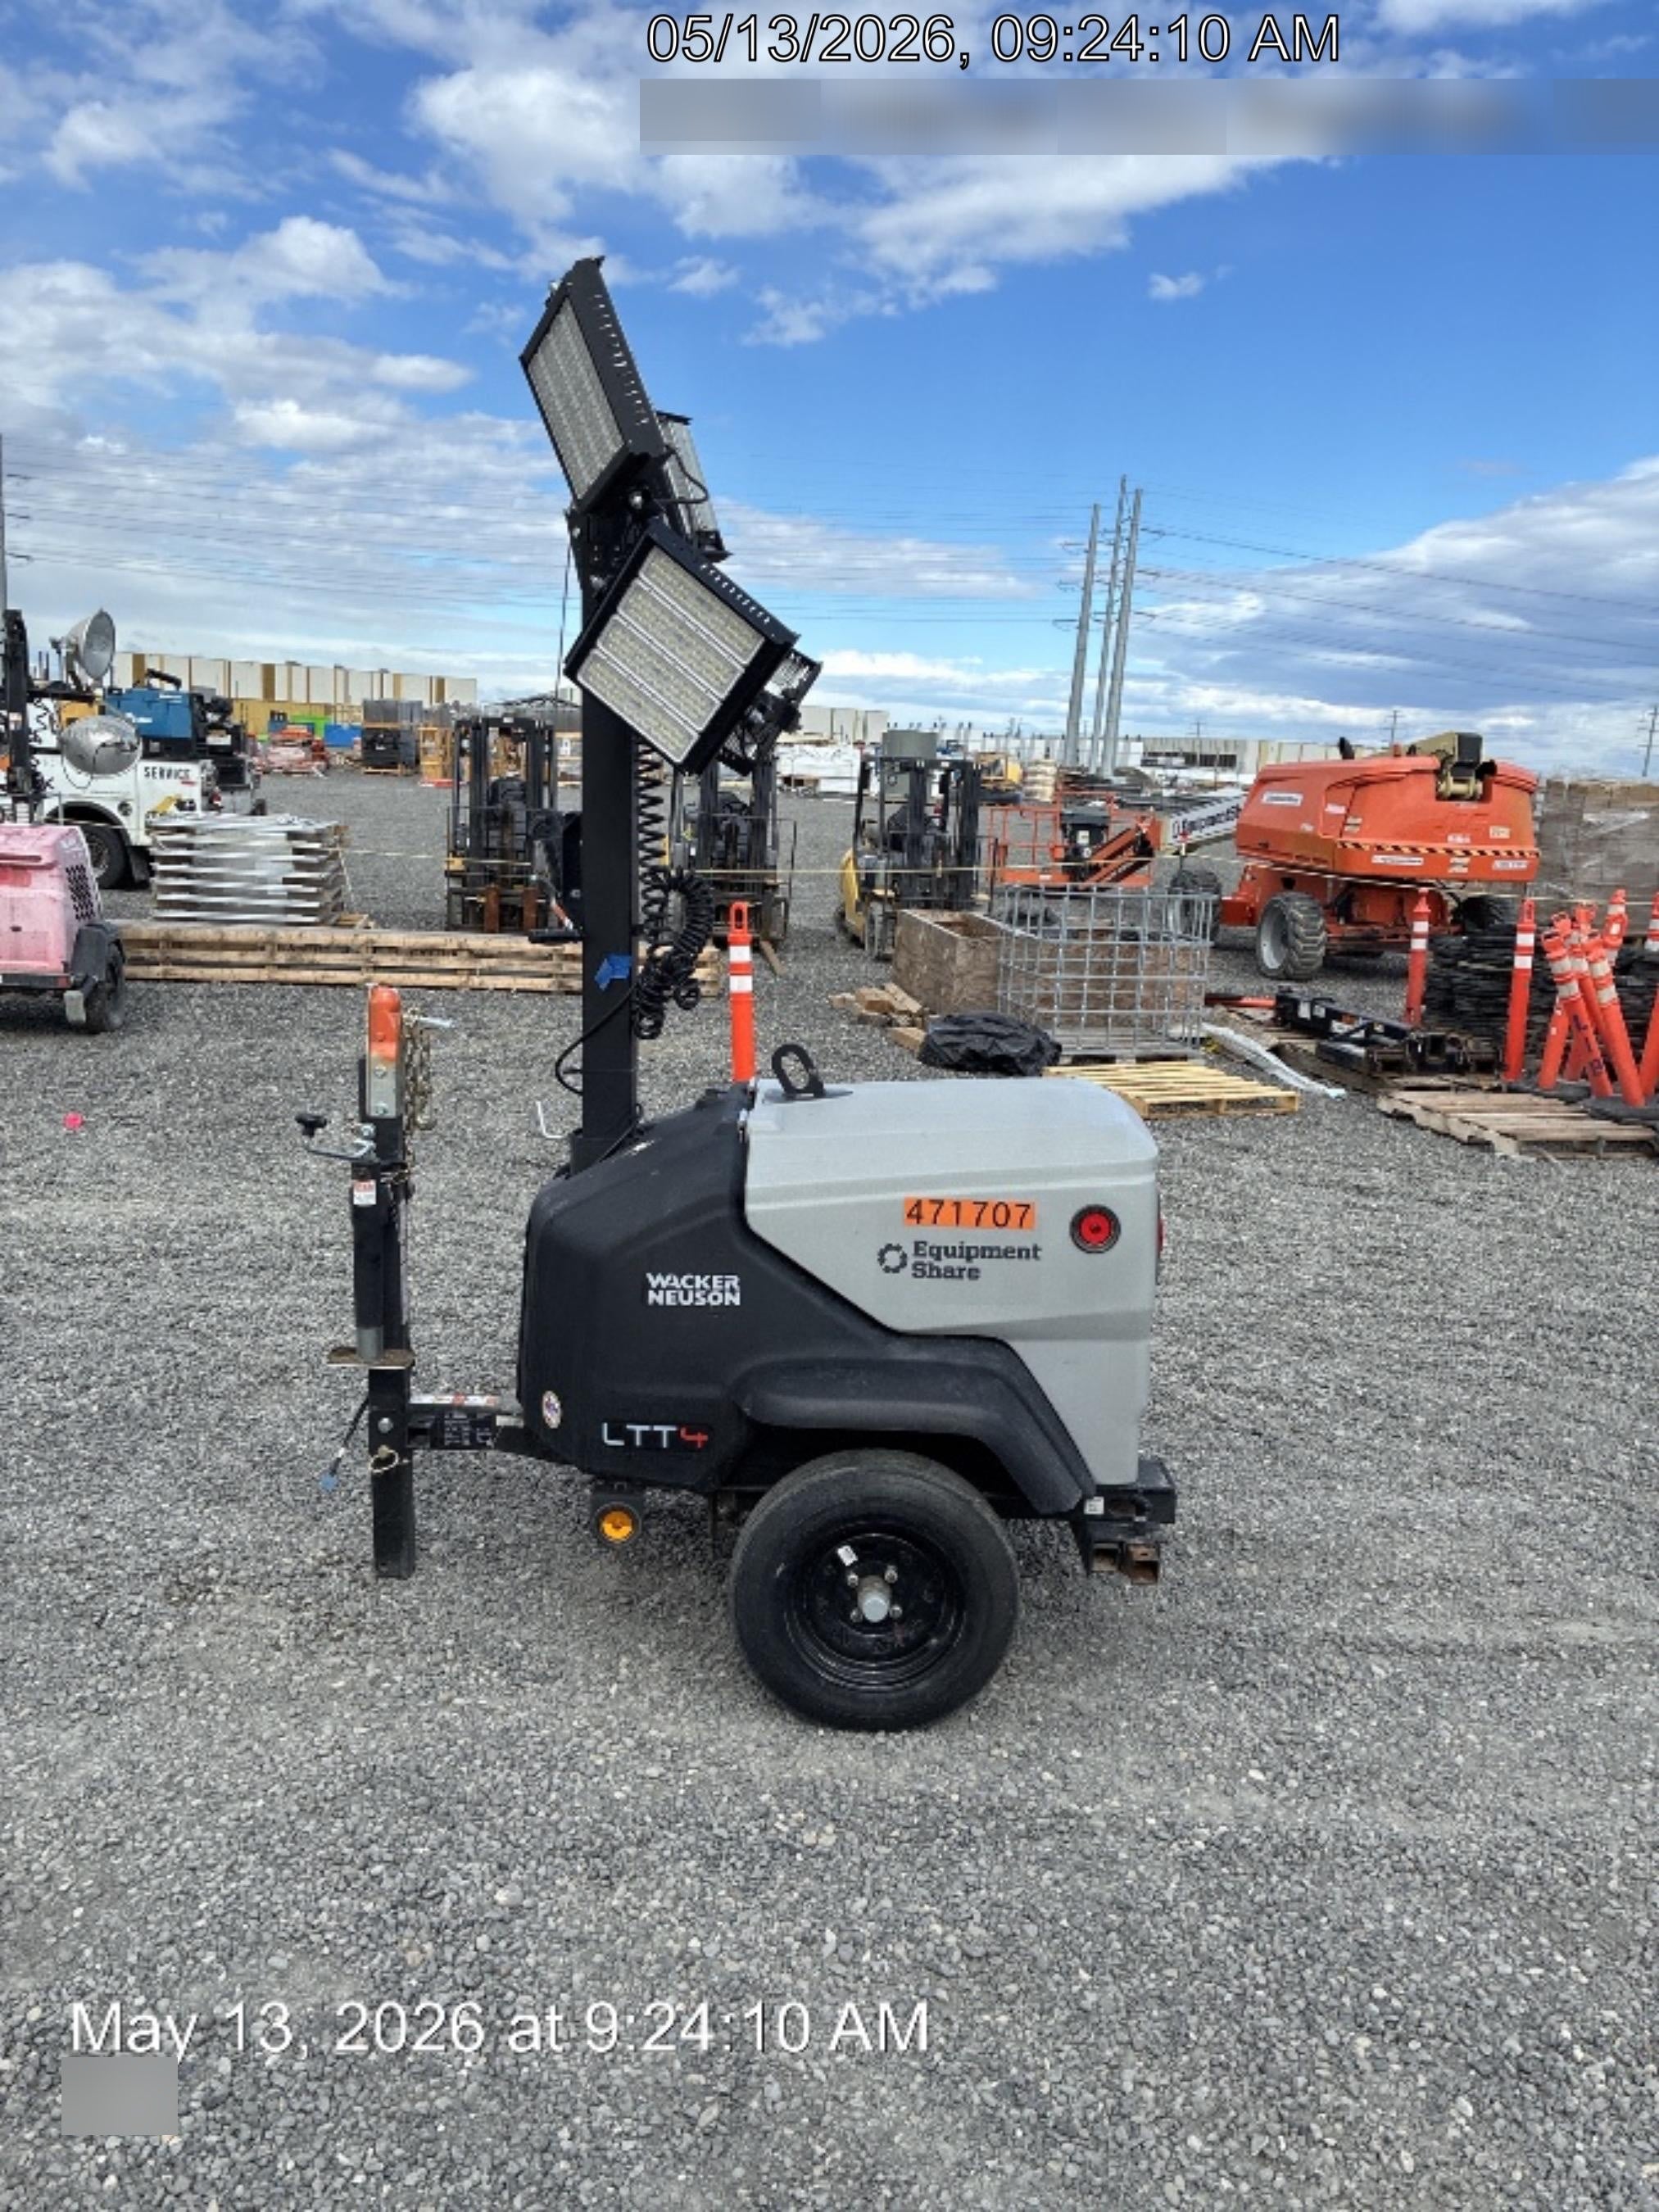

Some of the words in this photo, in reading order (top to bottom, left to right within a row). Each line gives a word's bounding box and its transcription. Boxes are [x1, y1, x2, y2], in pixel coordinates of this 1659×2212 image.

[906, 1199, 1031, 1228] 471707
[913, 1240, 1042, 1262] Equipment
[646, 1273, 741, 1290] WACKER
[911, 1262, 981, 1281] Share
[647, 1290, 741, 1306] NEUSON
[601, 1421, 709, 1448] LTT4
